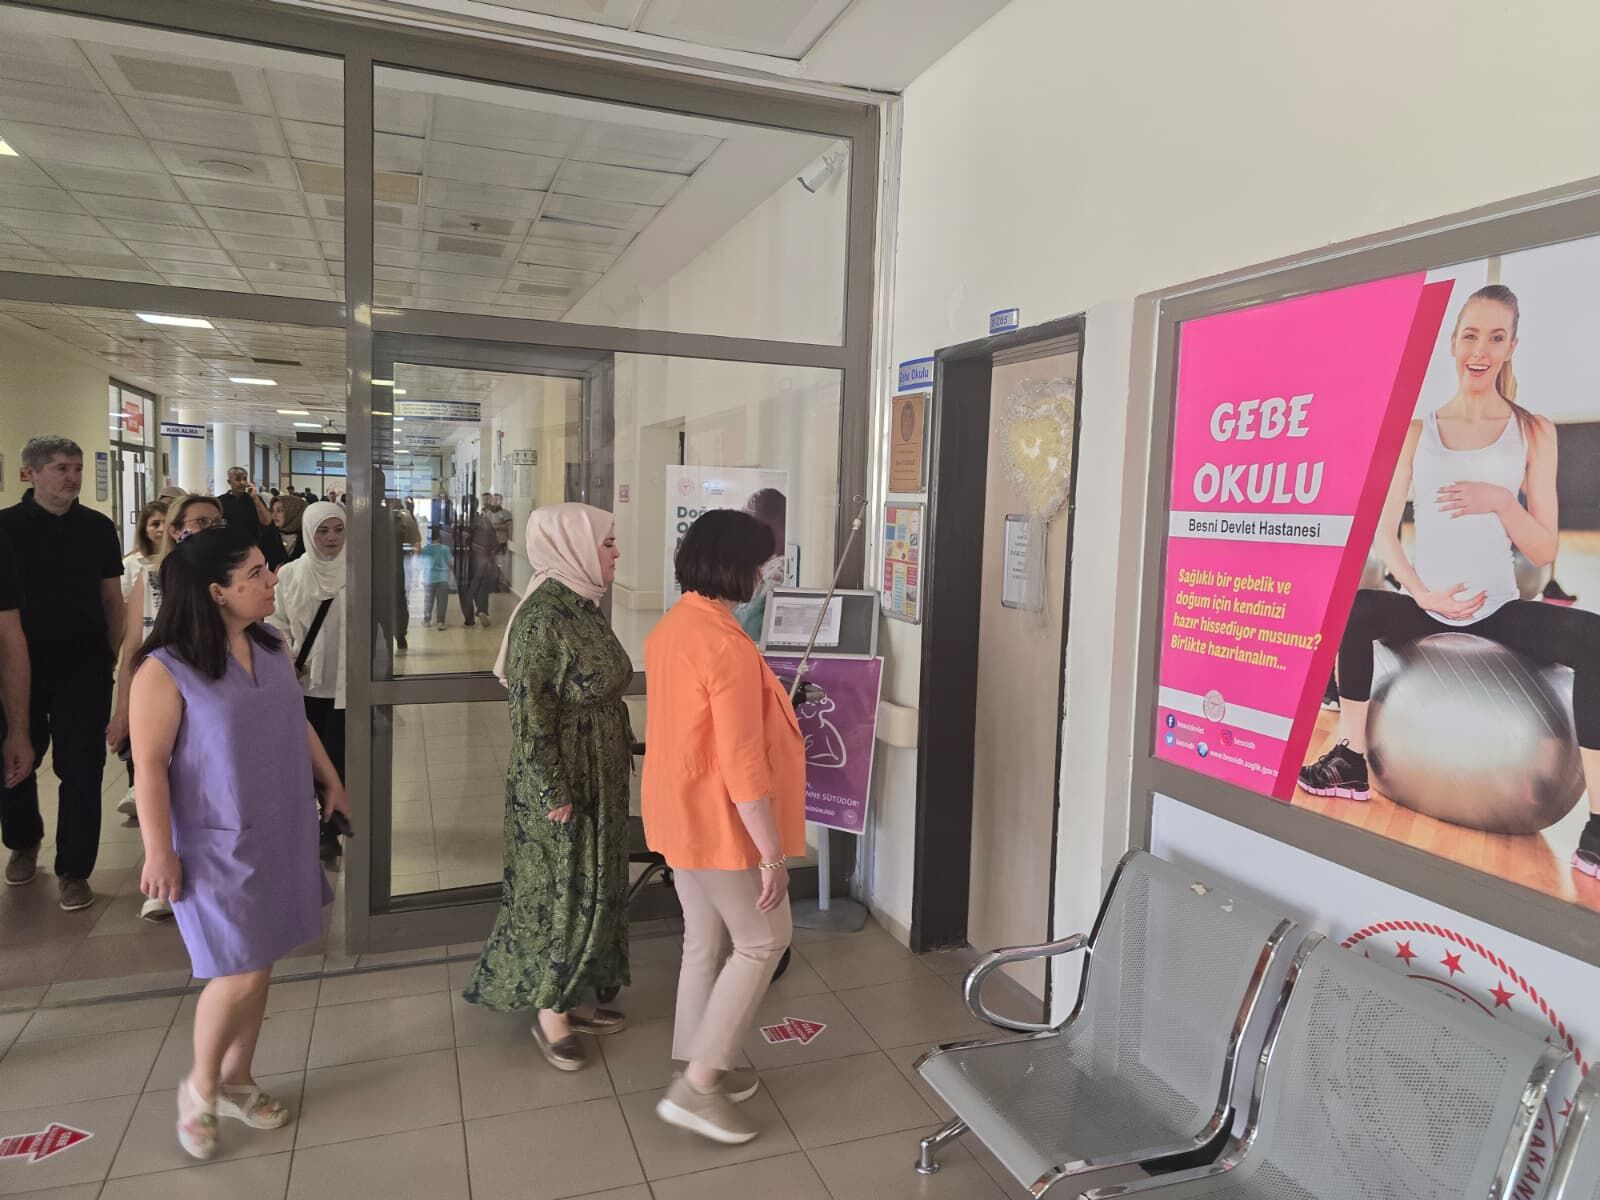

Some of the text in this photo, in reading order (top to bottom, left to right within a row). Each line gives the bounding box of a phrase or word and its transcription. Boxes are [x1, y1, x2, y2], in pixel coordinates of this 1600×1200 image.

[912, 367, 929, 380] Okulu
[1210, 393, 1314, 442] GEBE
[1193, 461, 1324, 505] OKULU
[1188, 518, 1321, 538] Besni Devlet Hastanesi
[1178, 568, 1291, 595] Sağlıklı bir gebelik ve
[1176, 591, 1287, 620] doğum için kendinizi
[1173, 612, 1323, 651] hazır hissediyor musunuz?
[1170, 634, 1287, 671] Birlikte hazırlanalım...
